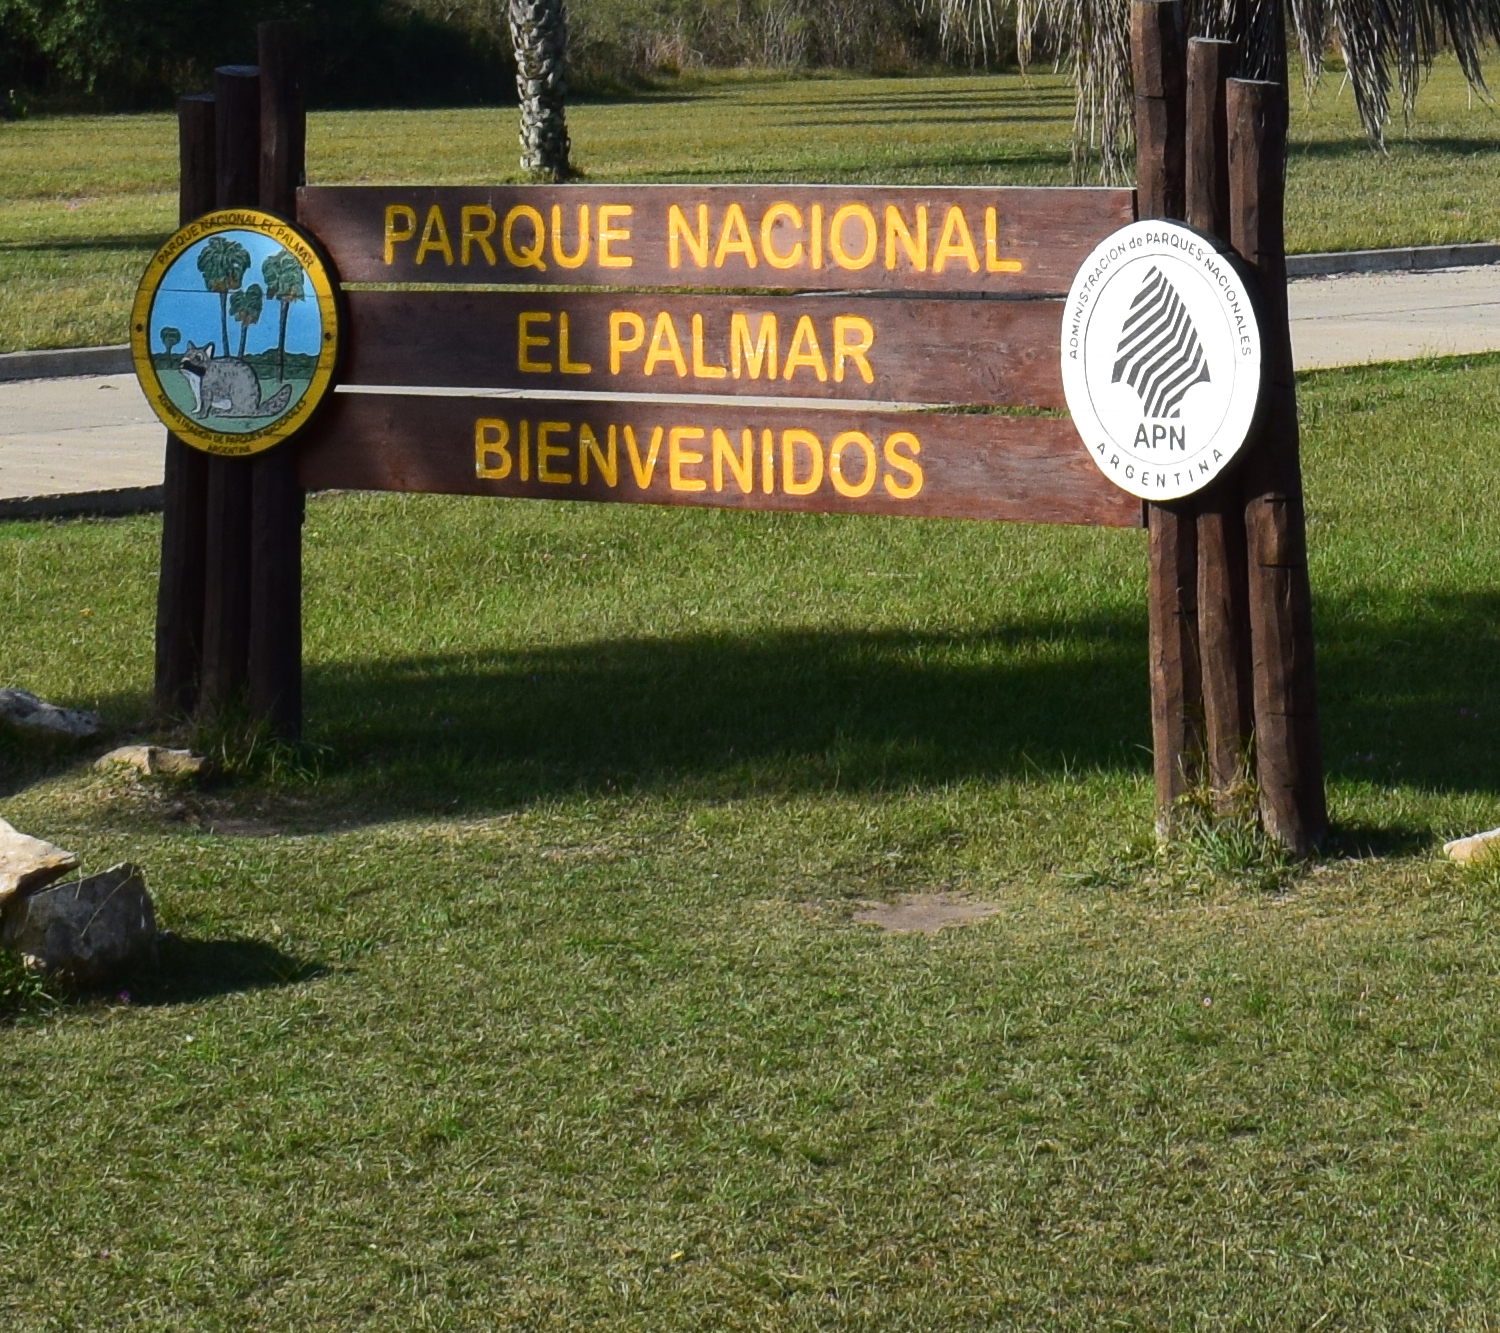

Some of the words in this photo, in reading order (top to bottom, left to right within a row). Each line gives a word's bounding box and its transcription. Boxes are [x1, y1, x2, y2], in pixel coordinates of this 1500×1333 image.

[157, 225, 201, 265] PARQUE
[200, 213, 257, 232] NACIONAL
[261, 219, 274, 234] EL
[276, 228, 314, 269] PALMAR
[383, 203, 635, 271] PARQUE
[666, 201, 1023, 272] NACIONAL
[1070, 245, 1127, 359] ADMINISTRACION
[1129, 236, 1144, 250] de
[1146, 232, 1204, 261] PARQUES
[1203, 257, 1252, 356] NACIONALES
[516, 310, 591, 374] EL
[608, 310, 875, 384] PALMAR
[474, 418, 924, 499] BIENVENIDOS
[1096, 442, 1223, 487] ARGENTINA
[1133, 423, 1186, 451] APN
